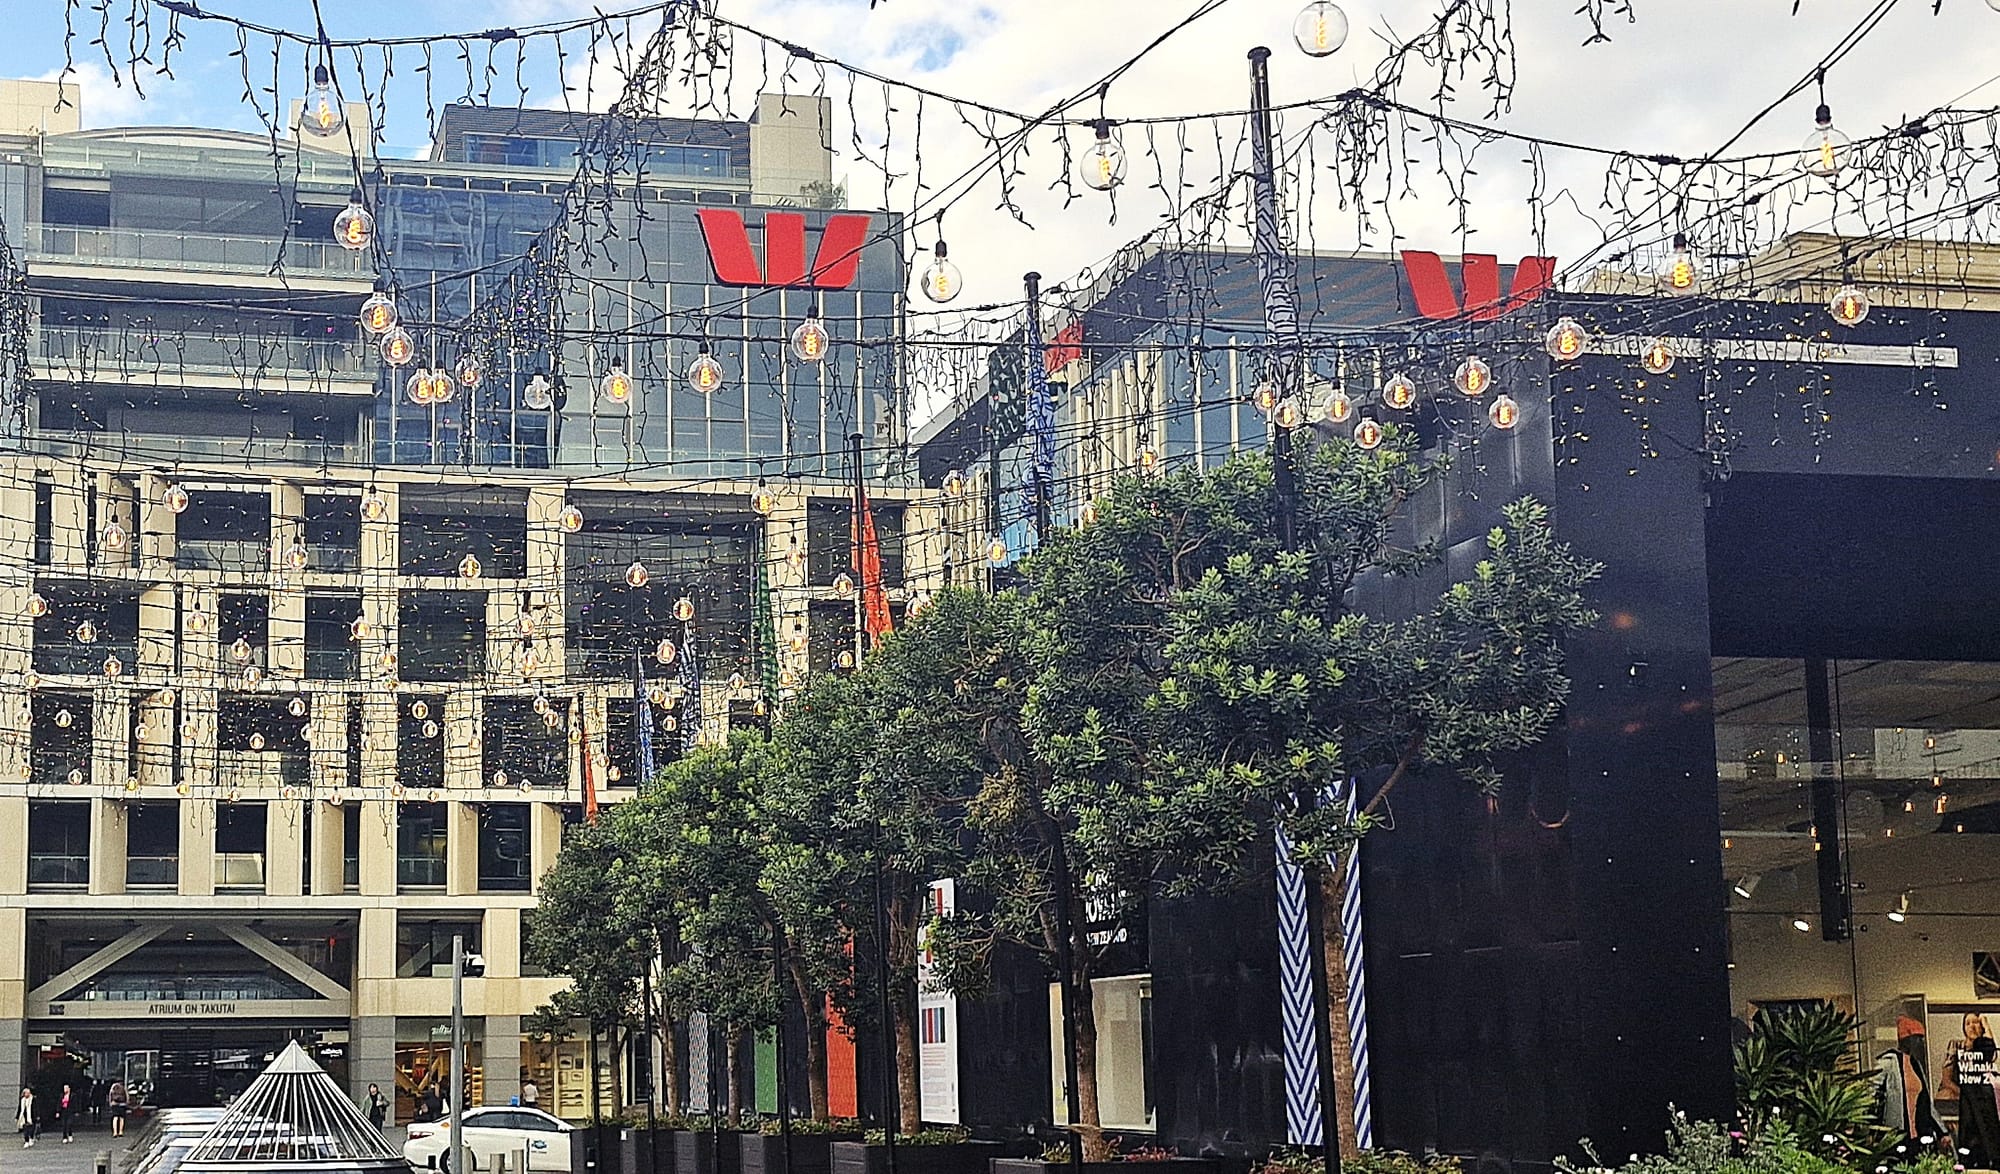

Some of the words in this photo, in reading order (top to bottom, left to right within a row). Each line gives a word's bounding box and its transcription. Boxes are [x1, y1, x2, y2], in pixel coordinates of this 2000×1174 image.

[148, 1003, 182, 1014] ATRIUM
[184, 1003, 198, 1014] ON
[200, 1003, 236, 1014] TAKUTAI
[1957, 1049, 1983, 1060] From
[1959, 1073, 1981, 1084] New
